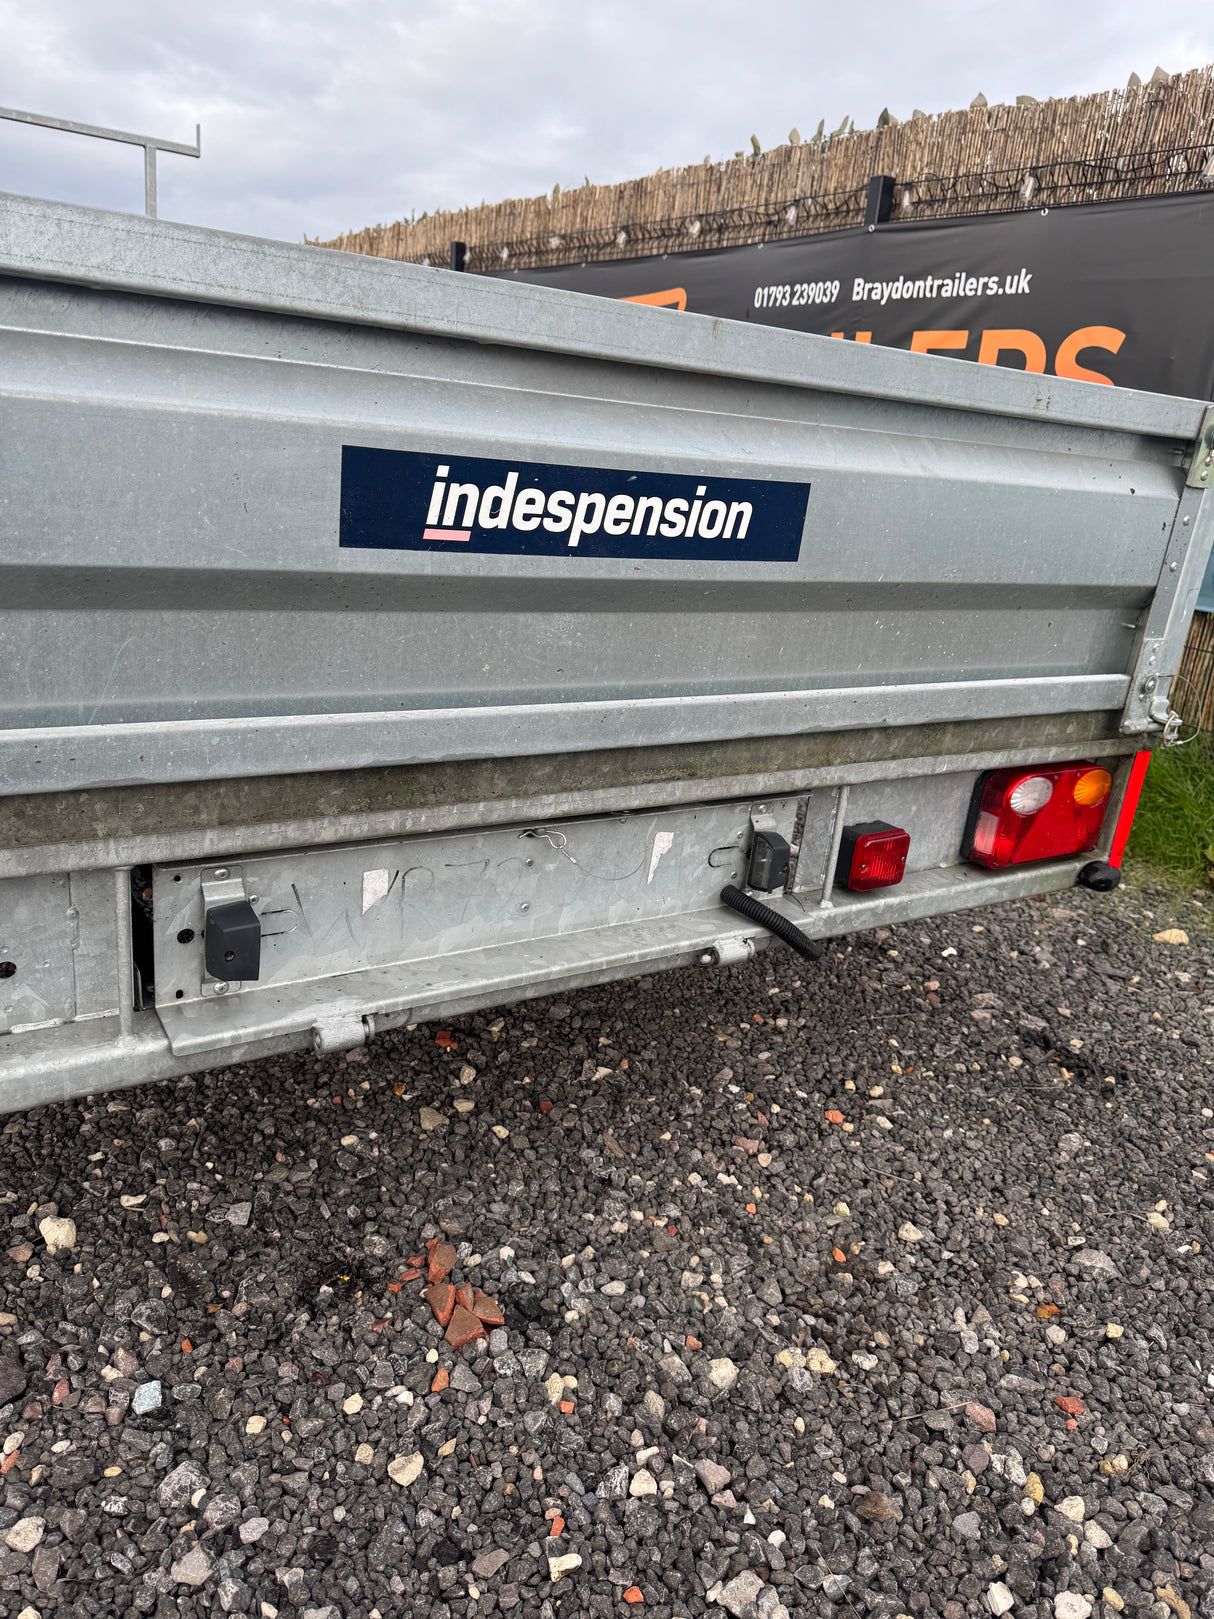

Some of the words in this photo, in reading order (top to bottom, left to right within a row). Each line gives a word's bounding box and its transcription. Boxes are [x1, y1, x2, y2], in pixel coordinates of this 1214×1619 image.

[754, 284, 791, 308] 01793
[792, 280, 840, 306] 239039
[852, 268, 1032, 305] Braydontrailers.uk
[426, 465, 753, 547] indespension
